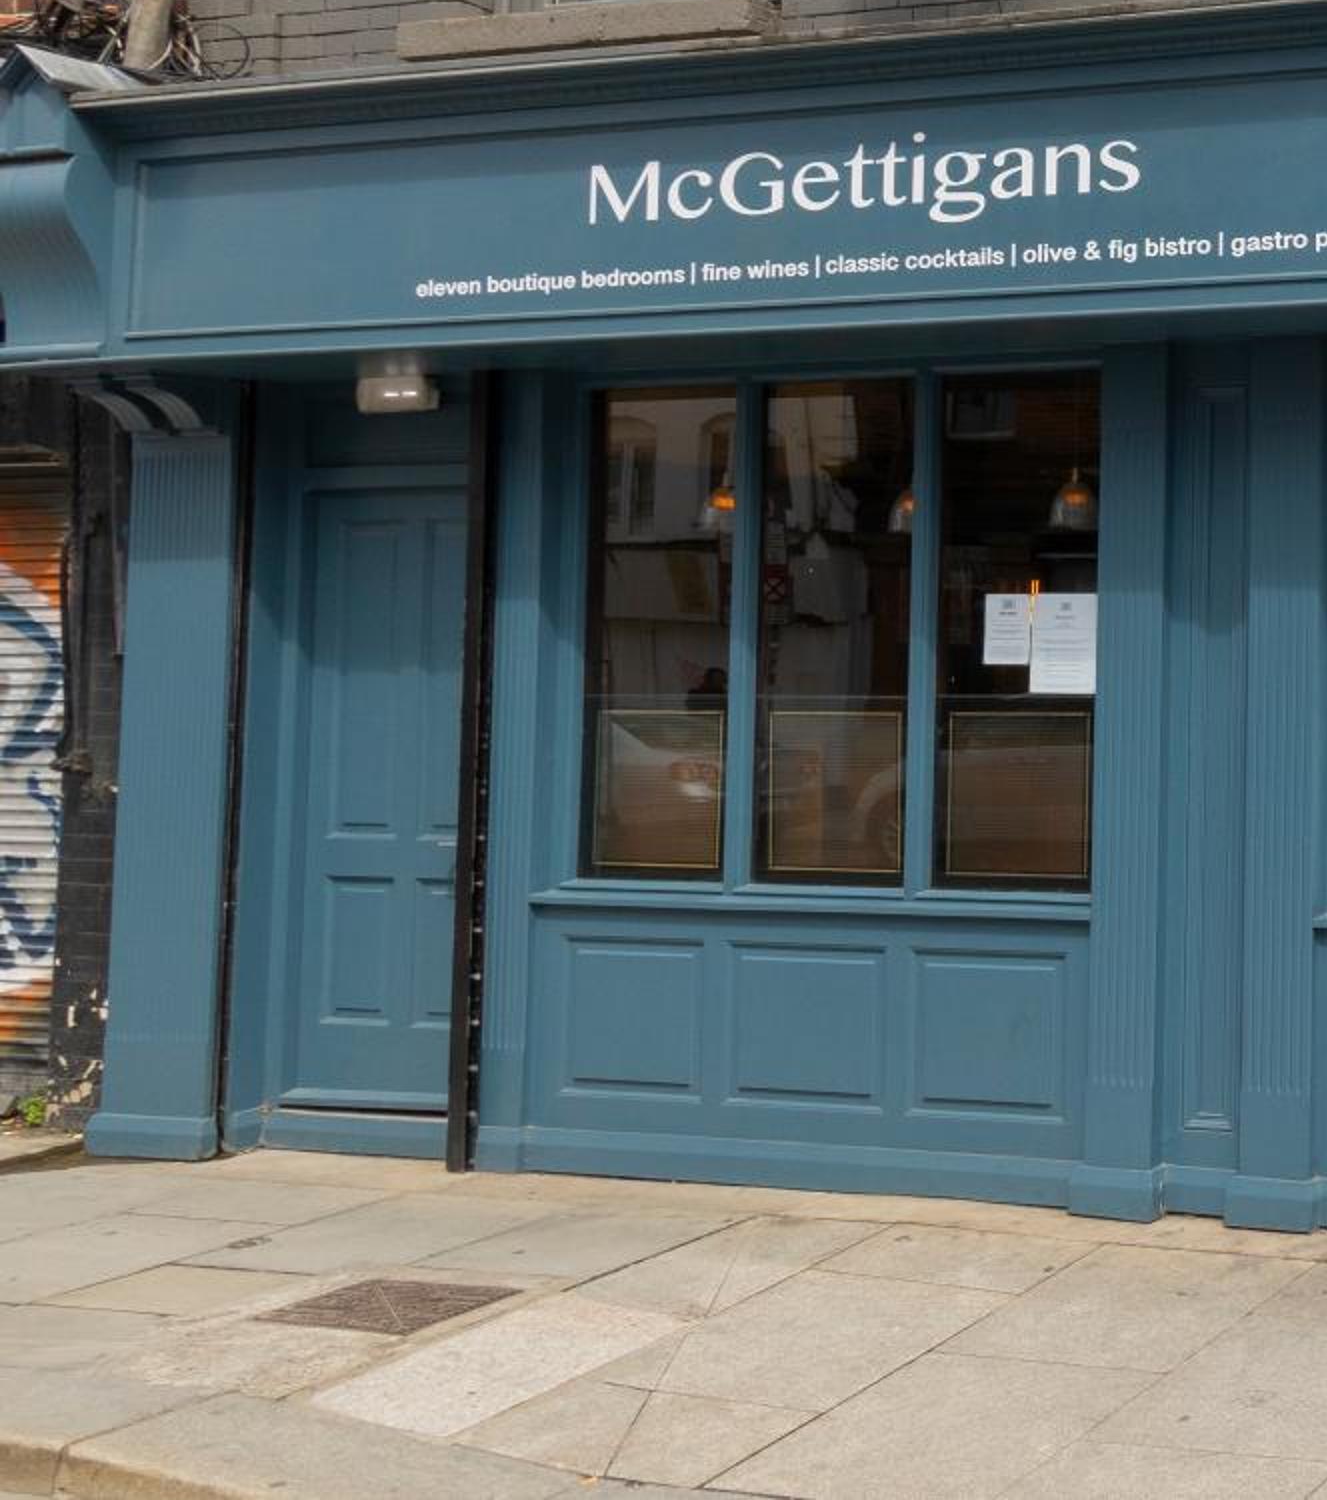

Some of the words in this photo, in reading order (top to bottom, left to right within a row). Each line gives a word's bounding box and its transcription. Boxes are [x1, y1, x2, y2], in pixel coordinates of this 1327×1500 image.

[589, 131, 1142, 225] McGettigans
[415, 278, 481, 298] eleven
[486, 273, 576, 295] boutique
[581, 269, 685, 290] bedrooms
[702, 263, 741, 282] fine
[747, 258, 809, 279] wines
[825, 253, 899, 275] classic
[905, 247, 1005, 270] cocktails
[1023, 243, 1076, 264] olive
[1084, 242, 1101, 260] &
[1108, 239, 1138, 263] fig
[1145, 236, 1212, 258] bistro
[1231, 232, 1307, 256] gastro
